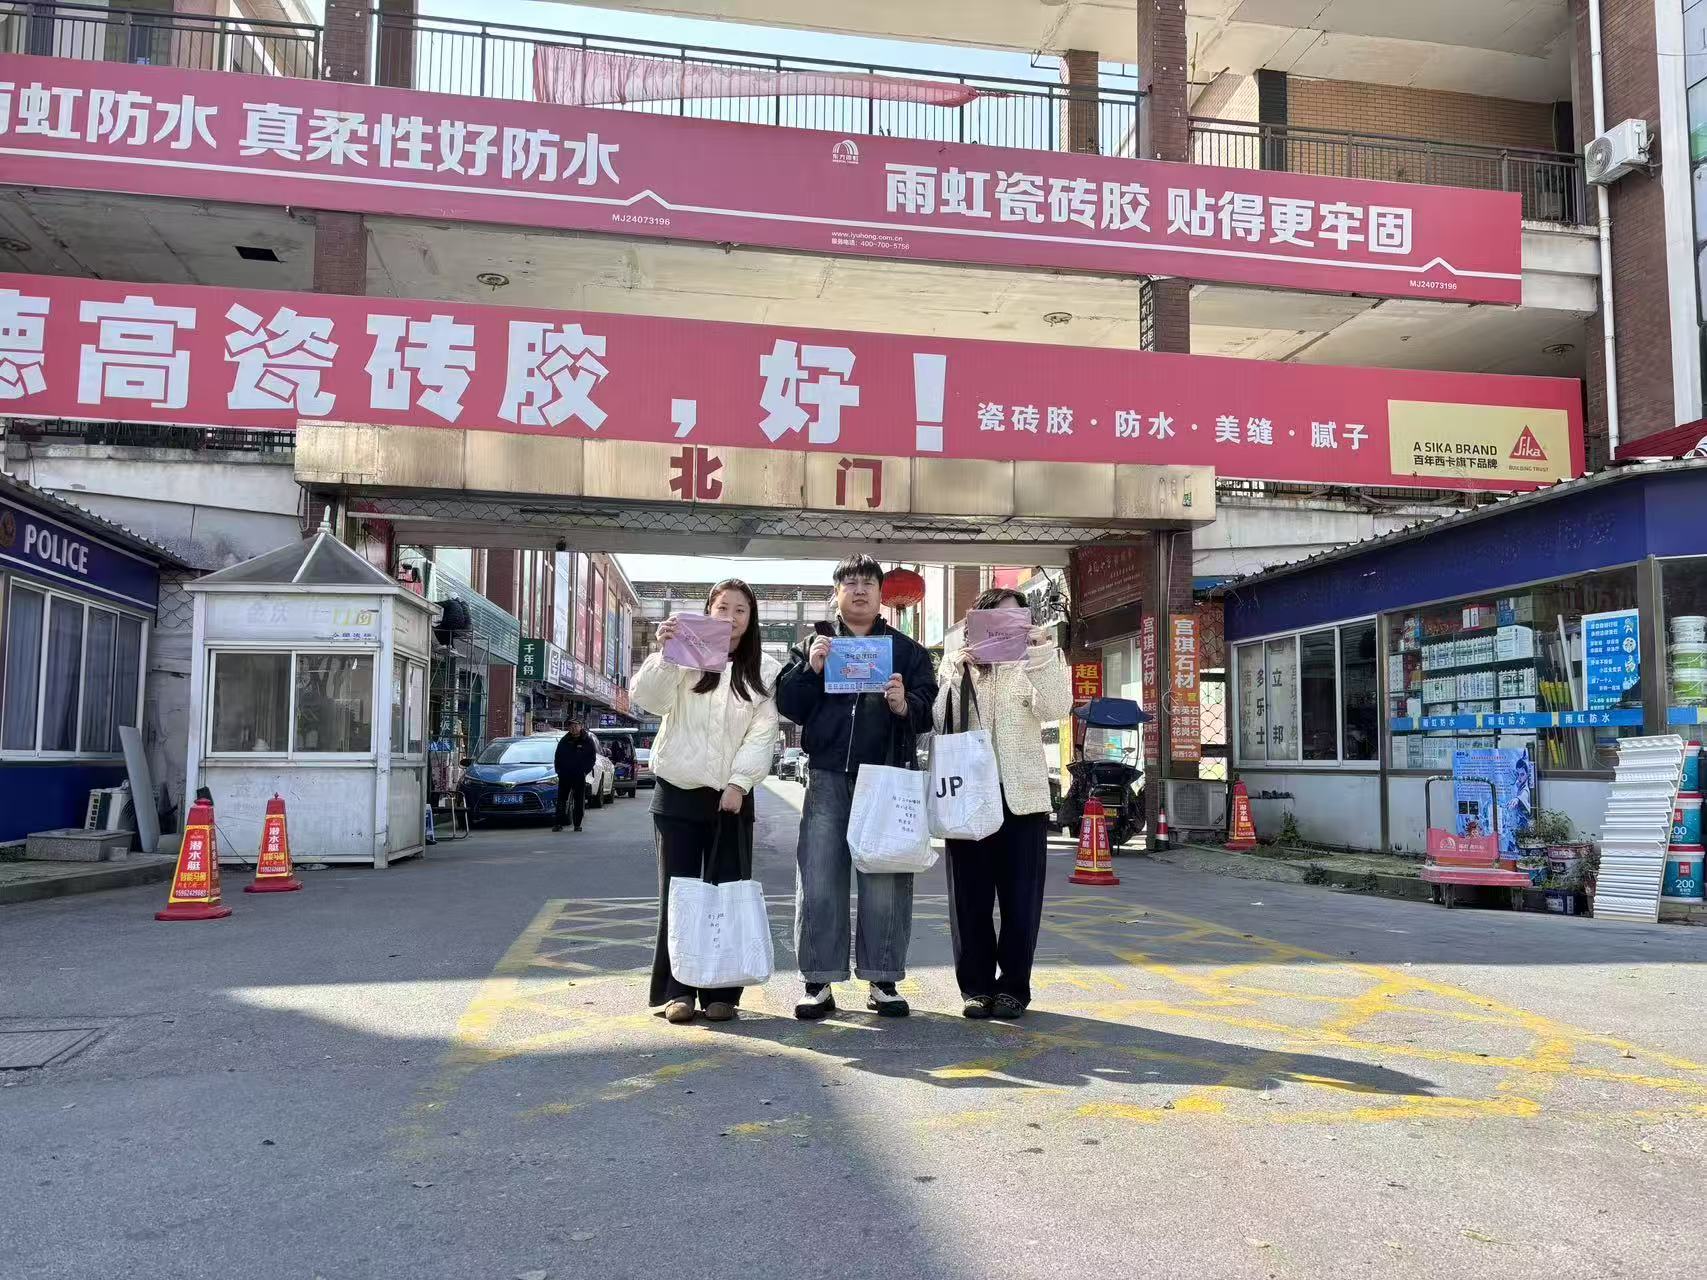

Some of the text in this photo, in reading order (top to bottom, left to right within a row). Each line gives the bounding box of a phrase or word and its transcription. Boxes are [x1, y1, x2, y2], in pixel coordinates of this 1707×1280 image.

[0, 81, 621, 187] 虹防水 真柔性好防水
[612, 213, 671, 226] MJ24073196
[884, 162, 1413, 256] 雨虹瓷砖胶 贴得更牢固
[1409, 279, 1458, 290] MJ24073196
[1413, 441, 1498, 456] A SIKA BRAND
[1513, 435, 1541, 457] Sika
[1413, 454, 1498, 470] 百年西卡旗下品牌
[669, 446, 883, 508] 北门
[23, 523, 89, 575] POLICE
[1075, 664, 1099, 695] 超市
[936, 775, 963, 799] JP
[268, 827, 281, 852] 潜水艇
[187, 840, 203, 871] 潜水艇
[1675, 879, 1695, 889] 200
